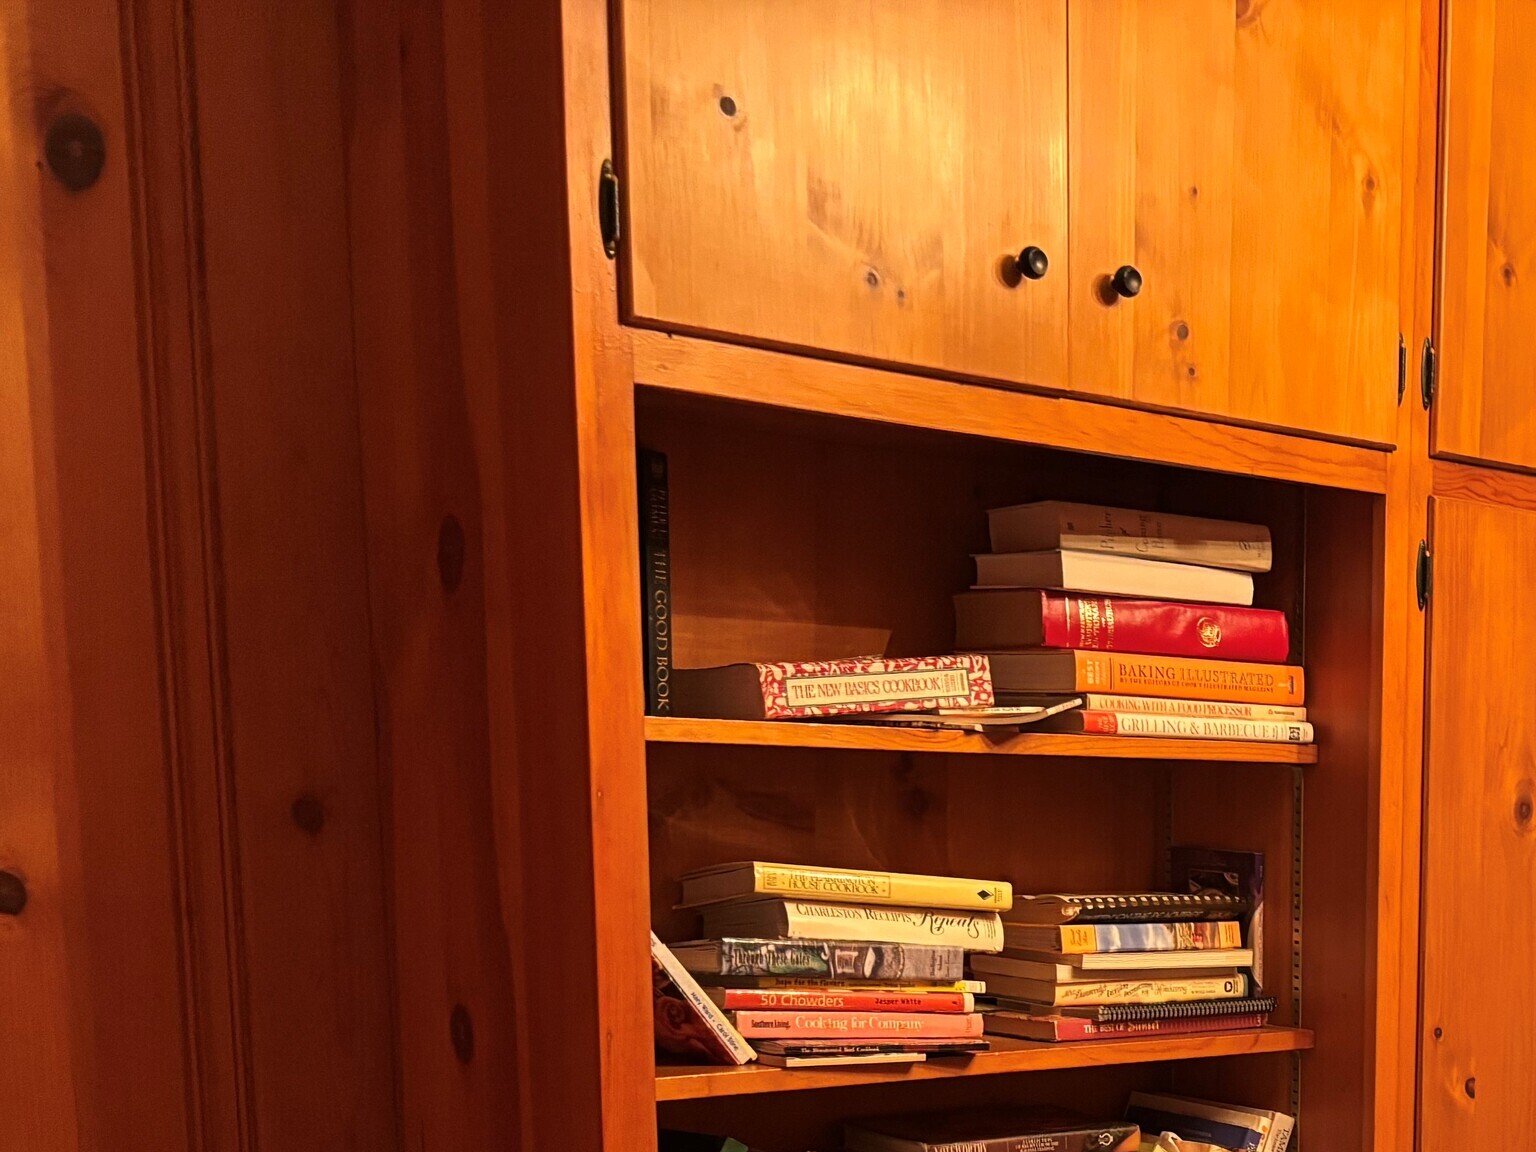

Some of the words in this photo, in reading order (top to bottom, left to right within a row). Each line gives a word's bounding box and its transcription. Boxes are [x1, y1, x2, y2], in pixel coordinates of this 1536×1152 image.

[655, 589, 669, 650] GOOD
[656, 655, 670, 712] BOOK
[1118, 663, 1176, 680] BAKING
[1180, 667, 1275, 686] ILLUSTRATED
[792, 684, 816, 700] THE
[818, 682, 841, 698] NEW
[844, 680, 880, 695] BASICS
[882, 677, 941, 693] COOKBOOK
[1100, 697, 1140, 710] COOKING
[1142, 700, 1166, 711] WITH
[1168, 701, 1176, 711] A
[1178, 702, 1201, 713] FOOD
[1202, 703, 1252, 716] PROCESSOR
[1121, 719, 1187, 734] GRILLING
[1191, 722, 1200, 734] &
[1204, 723, 1271, 738] BARBECUE
[789, 880, 821, 891] HOUSE
[823, 881, 879, 894] COOKBOOK
[912, 911, 980, 938] Repeats
[761, 995, 777, 1007] 50
[781, 994, 844, 1007] Chowders
[875, 998, 899, 1007] Jasper
[901, 998, 922, 1006] White
[751, 1019, 774, 1029] Southern
[795, 1015, 848, 1031] Cooking
[852, 1015, 867, 1029] for
[869, 1017, 925, 1032] Company
